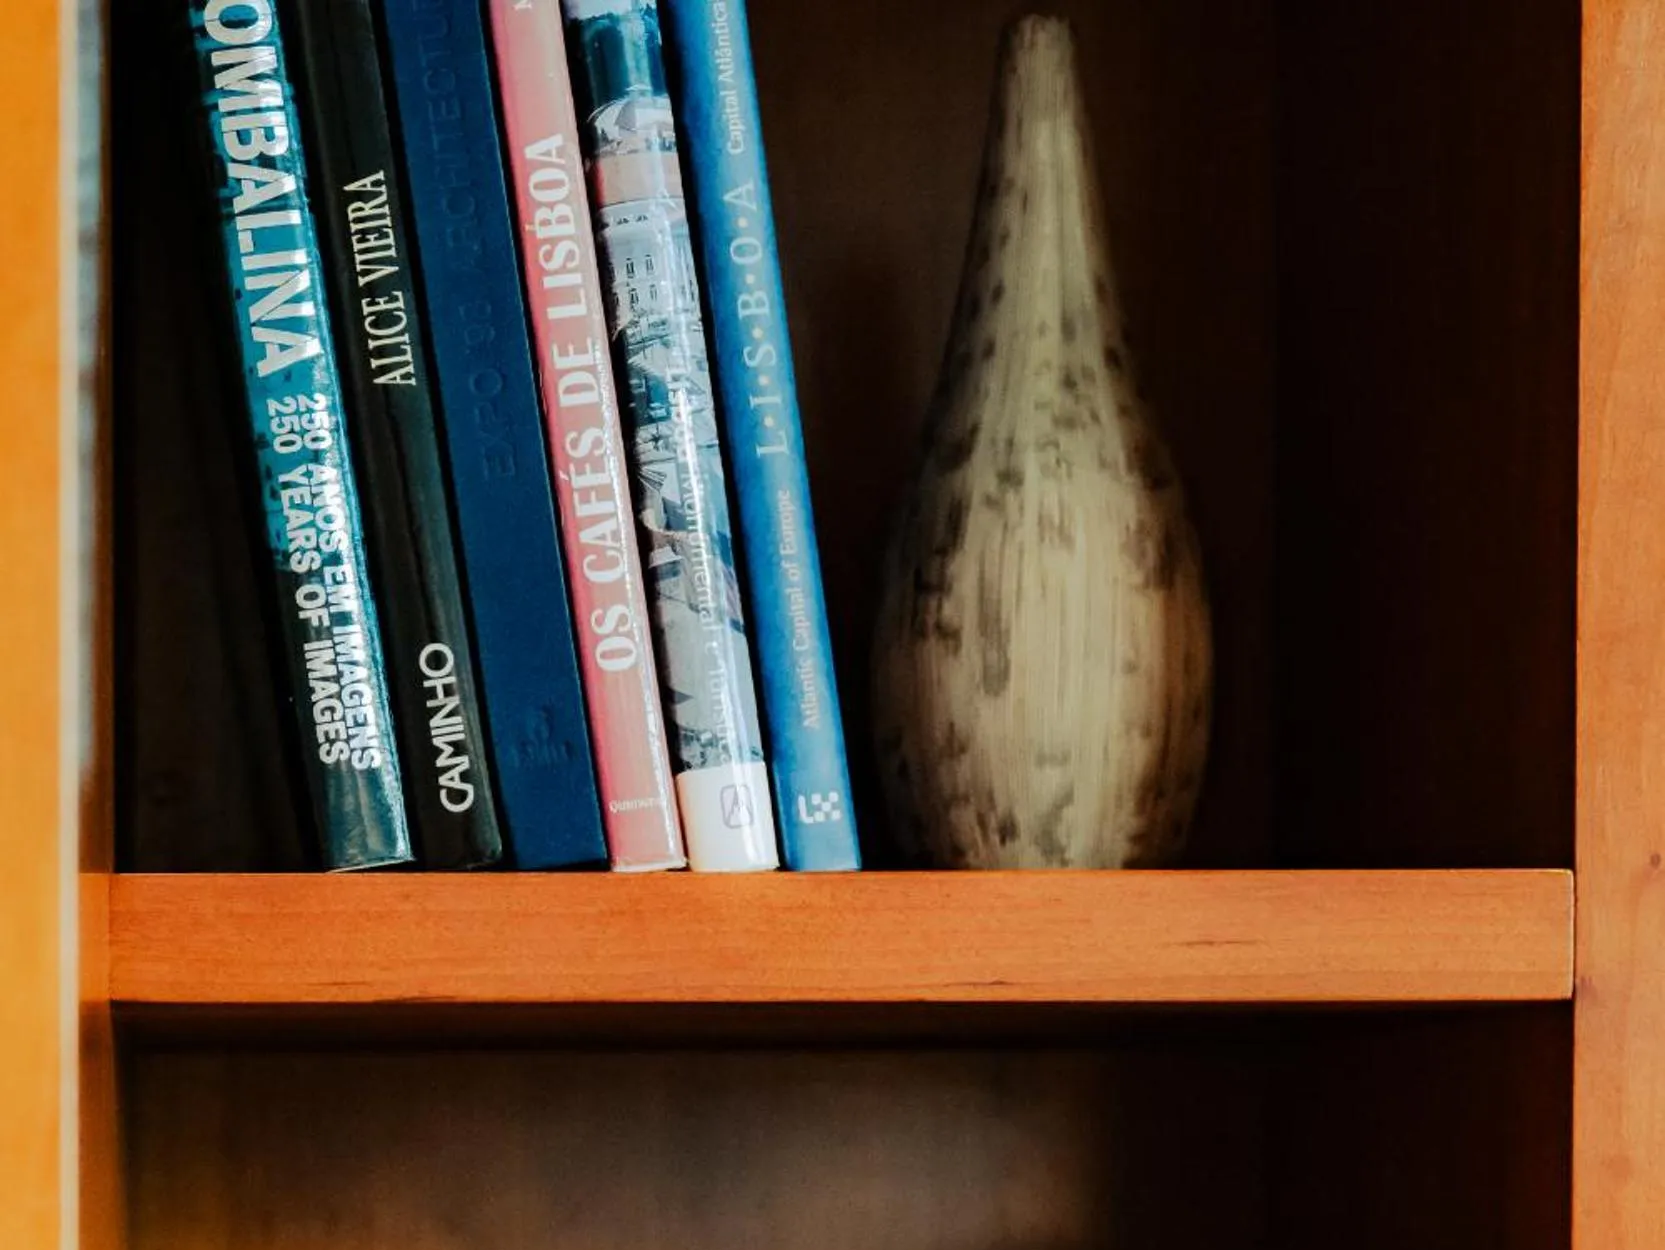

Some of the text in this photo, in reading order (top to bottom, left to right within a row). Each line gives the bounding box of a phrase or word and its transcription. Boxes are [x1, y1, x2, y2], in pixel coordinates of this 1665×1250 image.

[721, 91, 746, 156] Capital
[343, 170, 417, 386] ALICE VIEIRA
[522, 133, 638, 673] OS CAFÉS DE LISBOA
[267, 397, 349, 765] 250 YEARS OF IMAGES
[298, 396, 383, 770] 250 ANOS EM IMAGENS
[778, 490, 821, 731] Atlantic Capital of Europe
[418, 641, 474, 813] CAMINHO
